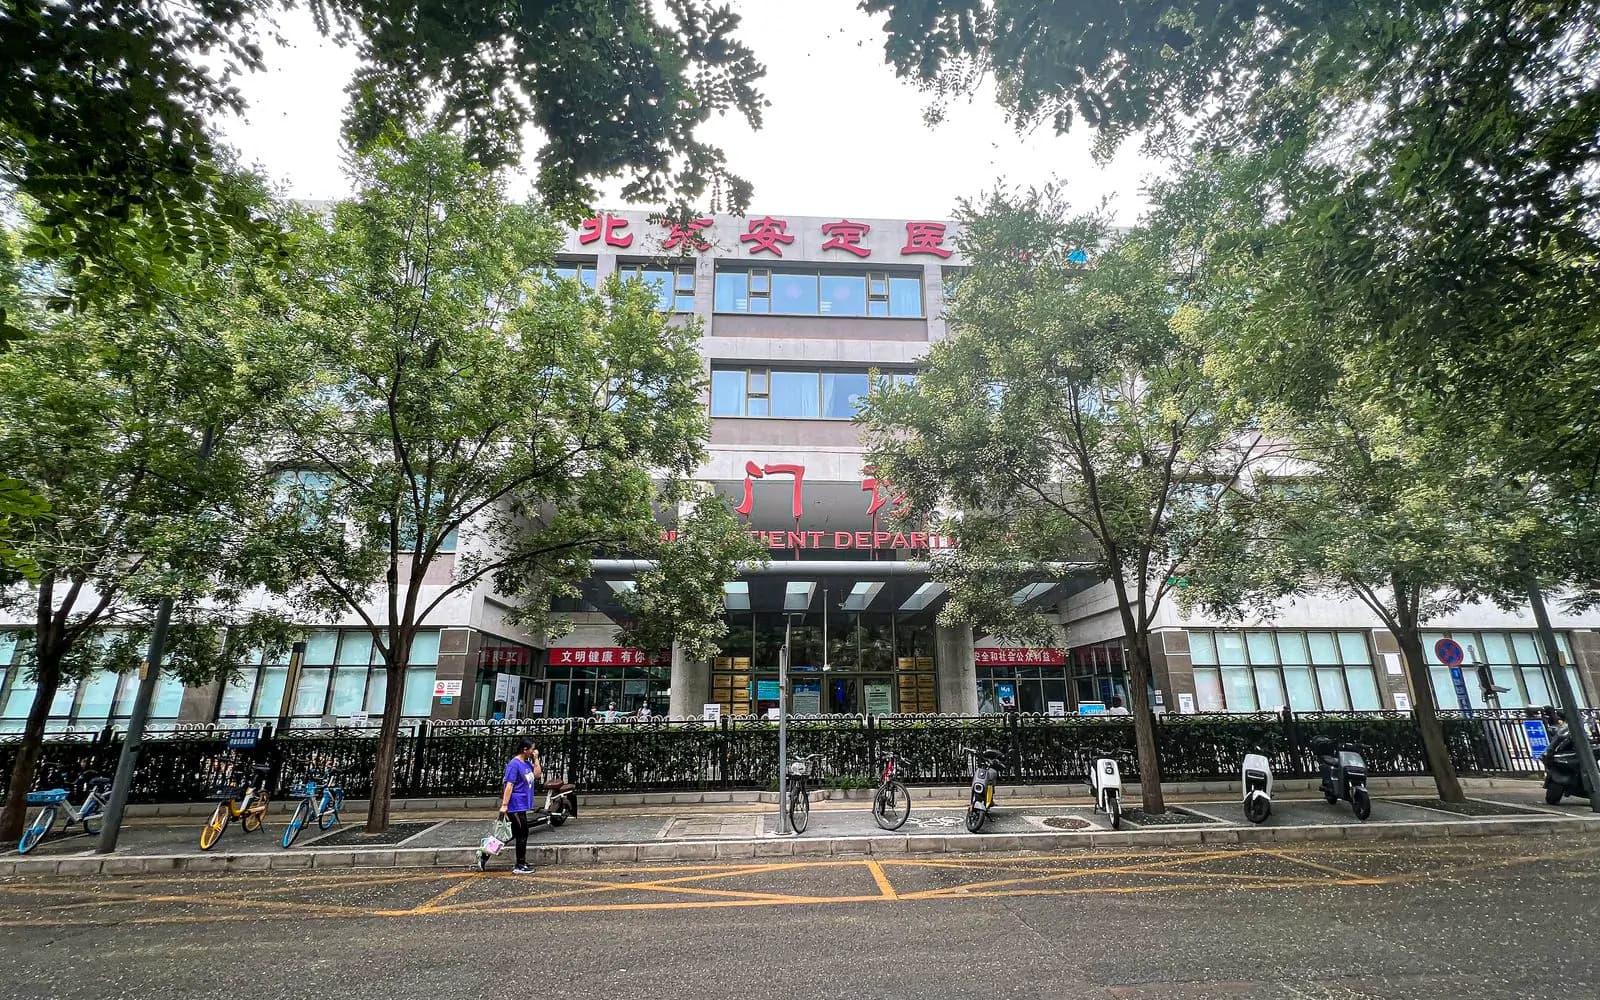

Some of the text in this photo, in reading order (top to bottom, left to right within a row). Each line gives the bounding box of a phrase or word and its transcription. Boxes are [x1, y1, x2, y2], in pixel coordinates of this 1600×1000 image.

[579, 215, 1033, 258] 北京安定医
[834, 531, 961, 550] DEPART
[561, 650, 613, 663] 文明健康
